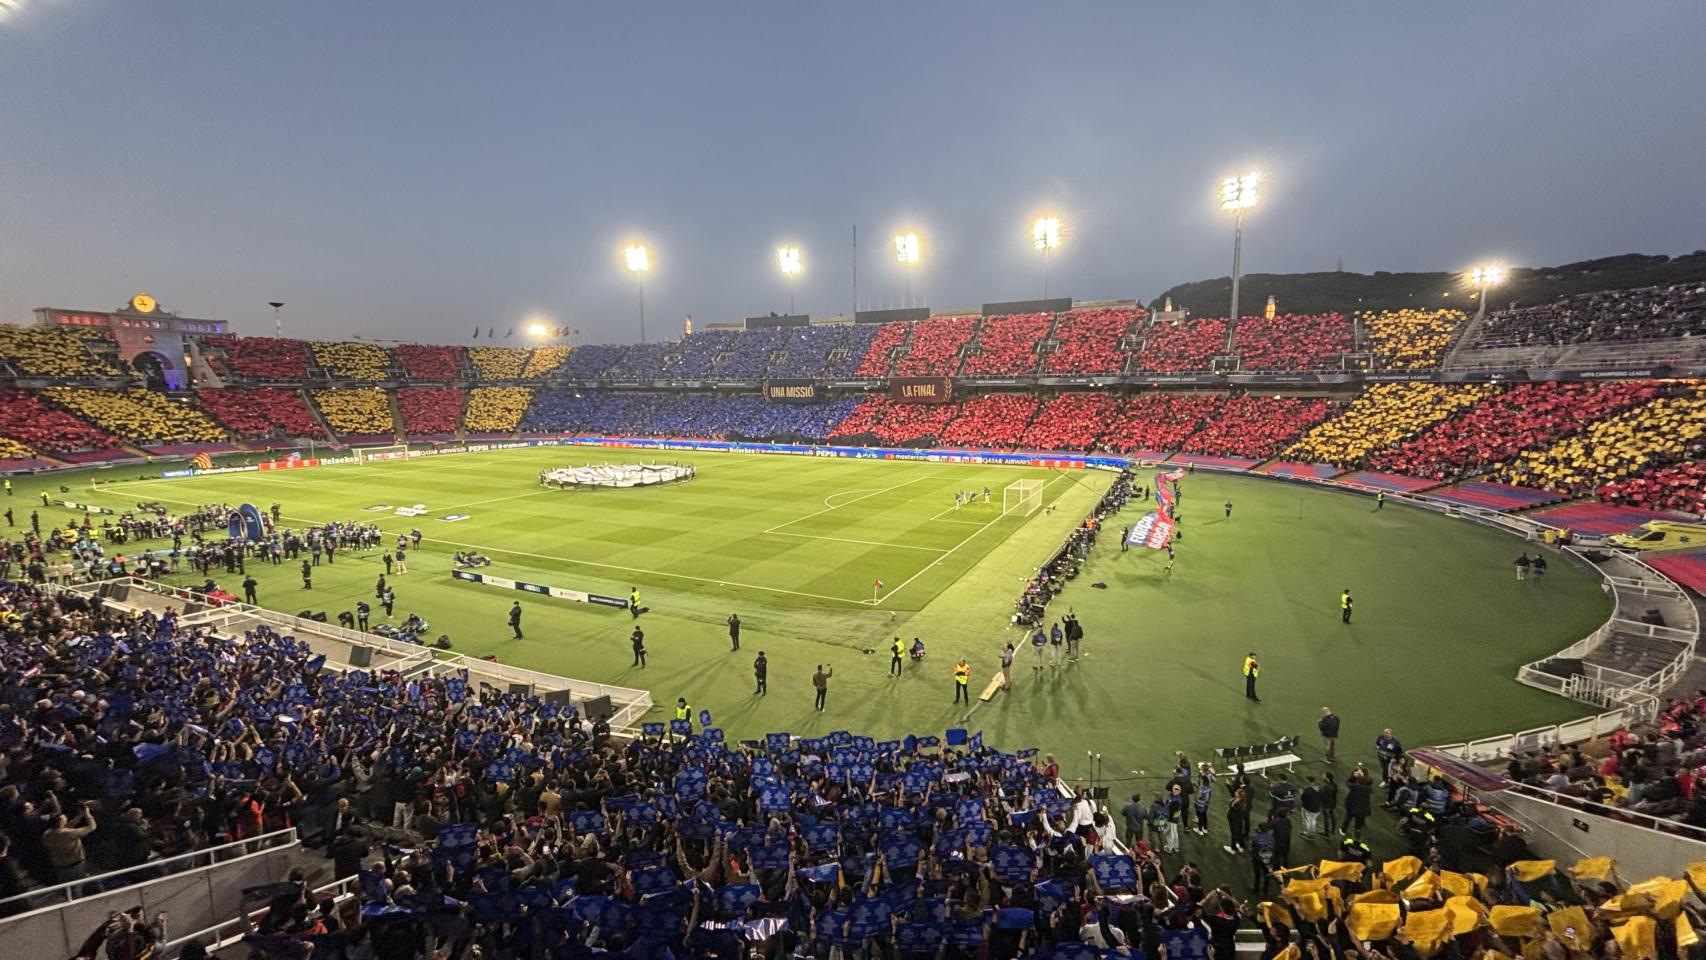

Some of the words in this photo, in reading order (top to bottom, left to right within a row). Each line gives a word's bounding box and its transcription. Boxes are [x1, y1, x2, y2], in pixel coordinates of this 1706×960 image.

[770, 386, 785, 398] UNA
[786, 383, 814, 398] MISSIÓ
[902, 385, 913, 398] LA
[913, 384, 936, 397] FINAL
[320, 456, 360, 466] Heineken
[982, 457, 1003, 465] QATAR
